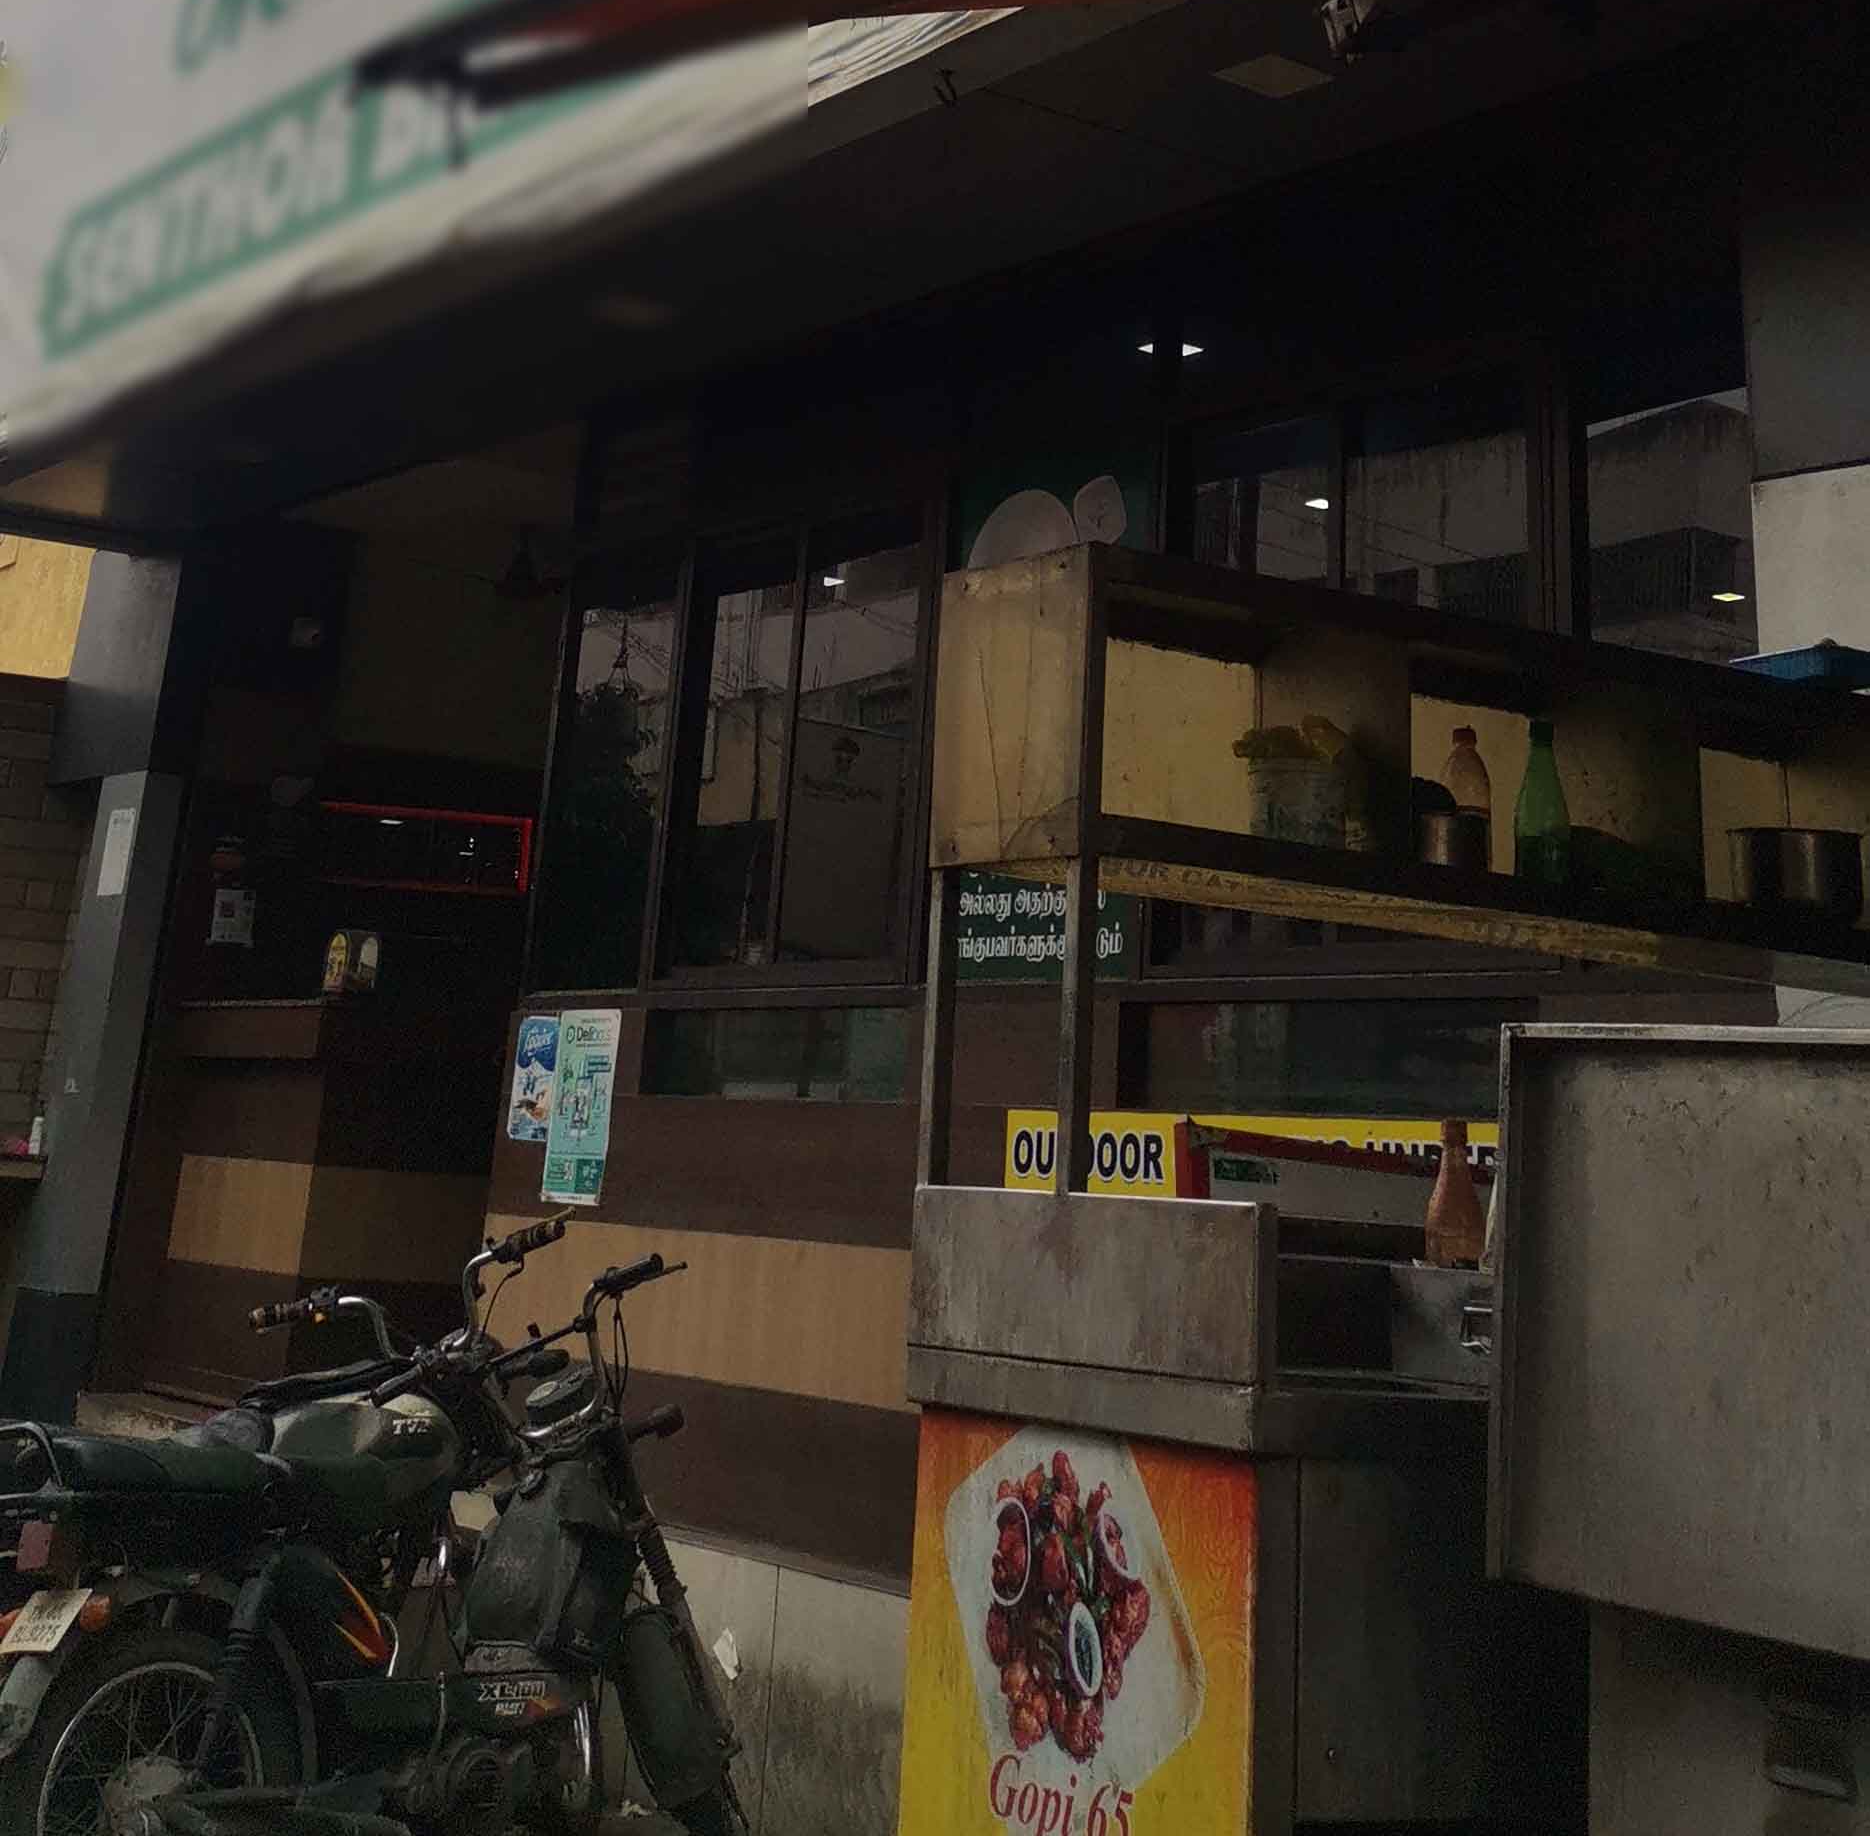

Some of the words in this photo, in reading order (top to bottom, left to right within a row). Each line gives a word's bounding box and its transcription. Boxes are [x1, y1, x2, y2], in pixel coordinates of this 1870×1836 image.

[958, 883, 1012, 923] அல்லது
[1013, 1129, 1165, 1183] OUOOR
[989, 1753, 1077, 1836] Gopi
[1087, 1781, 1134, 1836] 65
